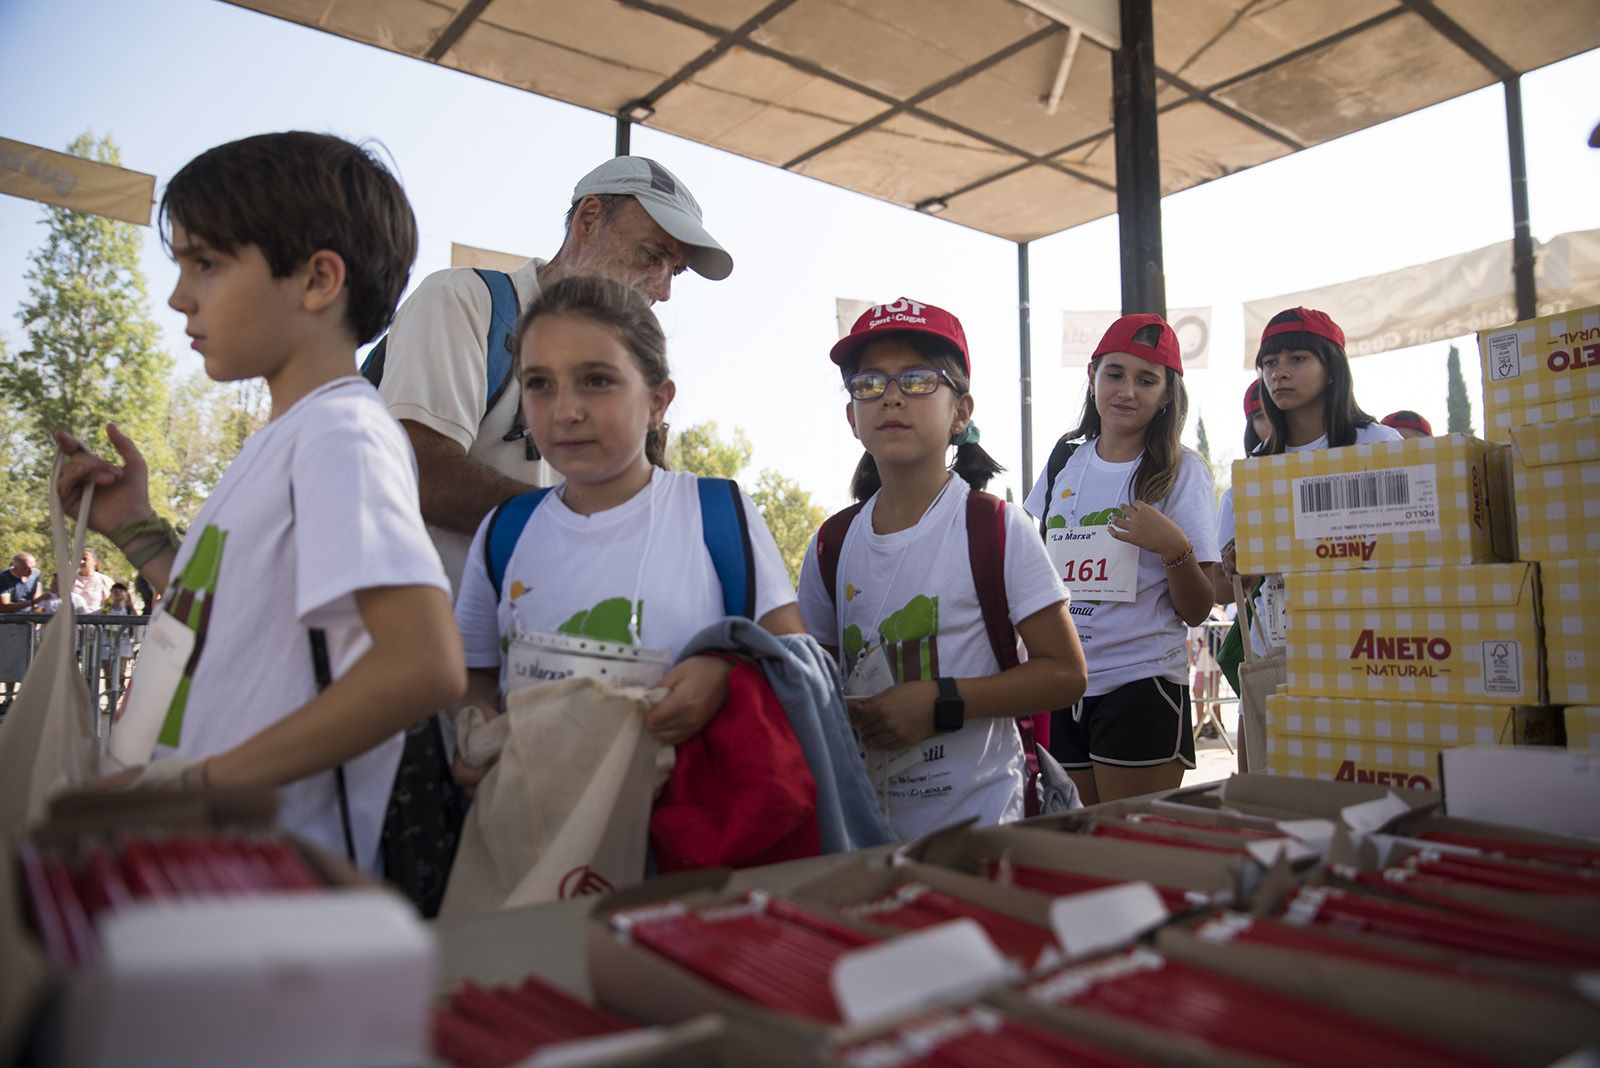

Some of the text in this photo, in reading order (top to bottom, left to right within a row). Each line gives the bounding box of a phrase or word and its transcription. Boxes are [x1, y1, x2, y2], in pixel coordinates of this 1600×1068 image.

[869, 314, 927, 329] Sant Cugat
[1547, 343, 1600, 372] ETO
[1405, 510, 1434, 519] POLLO
[1316, 541, 1377, 561] ANETO
[1063, 558, 1109, 583] 161
[1350, 629, 1452, 661] ANETO
[1366, 664, 1438, 678] NATURAL
[1334, 760, 1432, 790] ANETO
